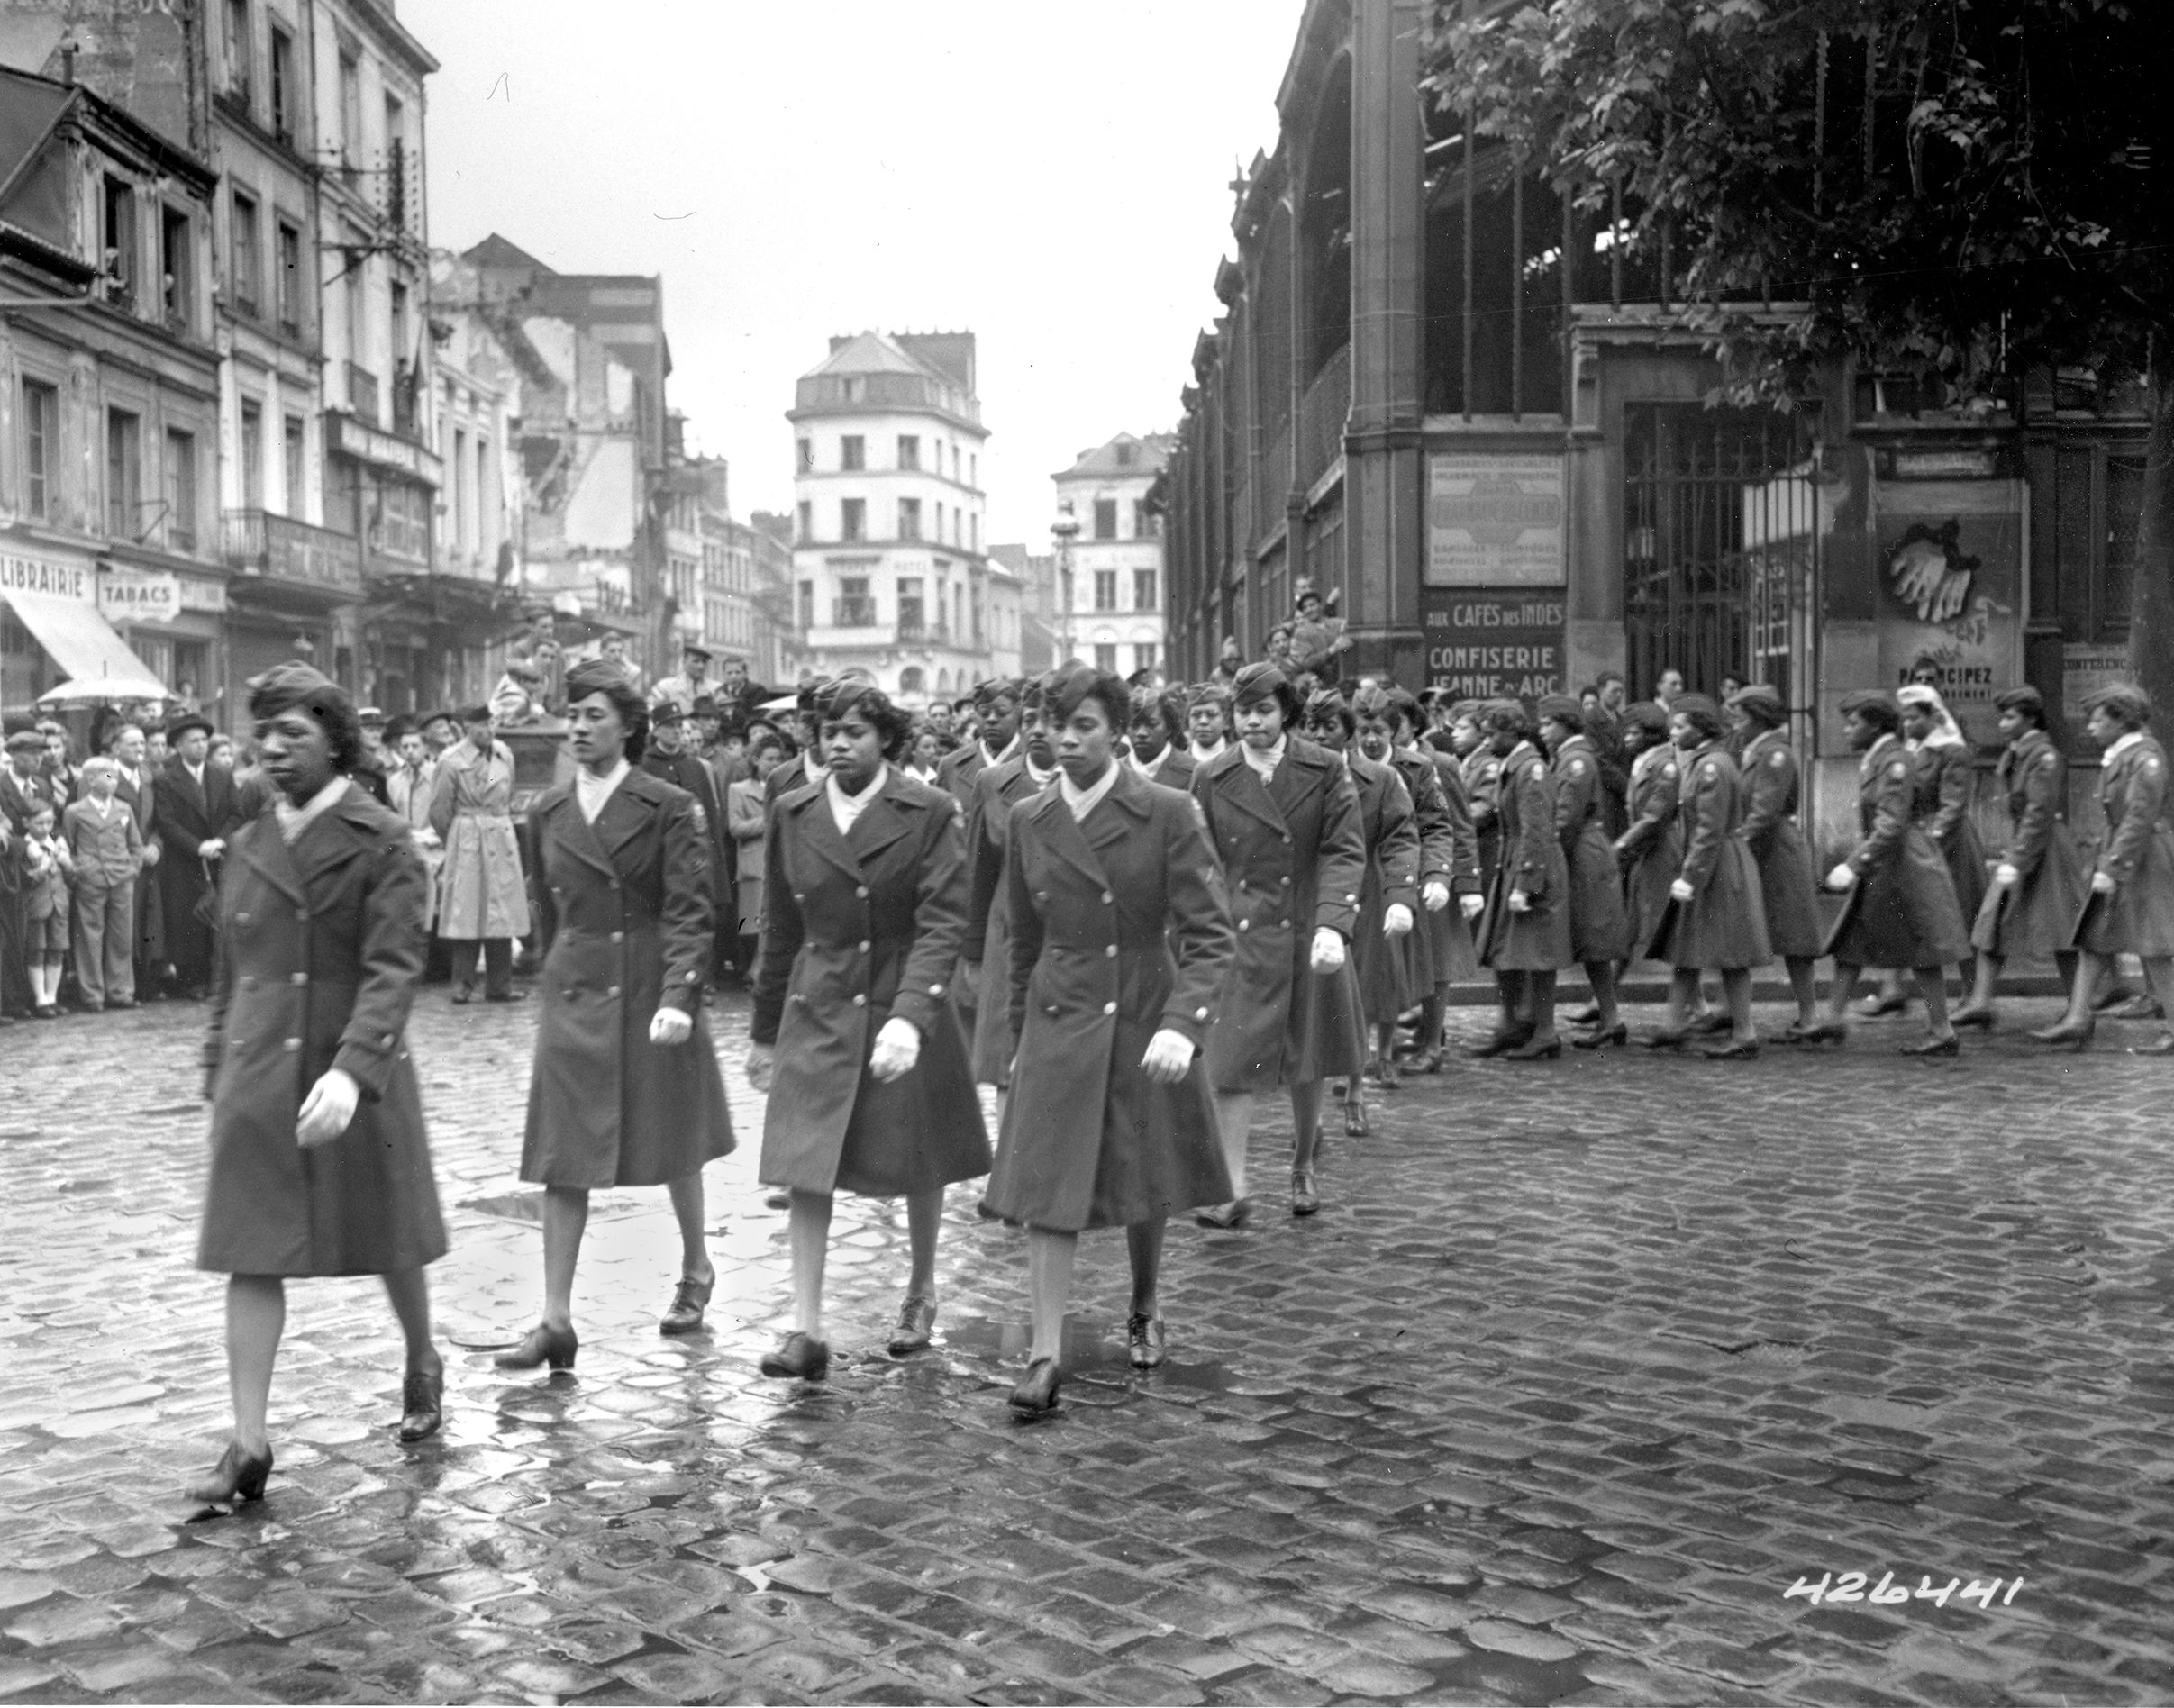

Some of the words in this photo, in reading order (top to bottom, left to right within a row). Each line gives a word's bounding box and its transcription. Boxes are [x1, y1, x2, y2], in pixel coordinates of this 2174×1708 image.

[105, 586, 171, 603] TABACS
[1521, 603, 1563, 627] INDES
[1429, 647, 1555, 669] CONFISERIE
